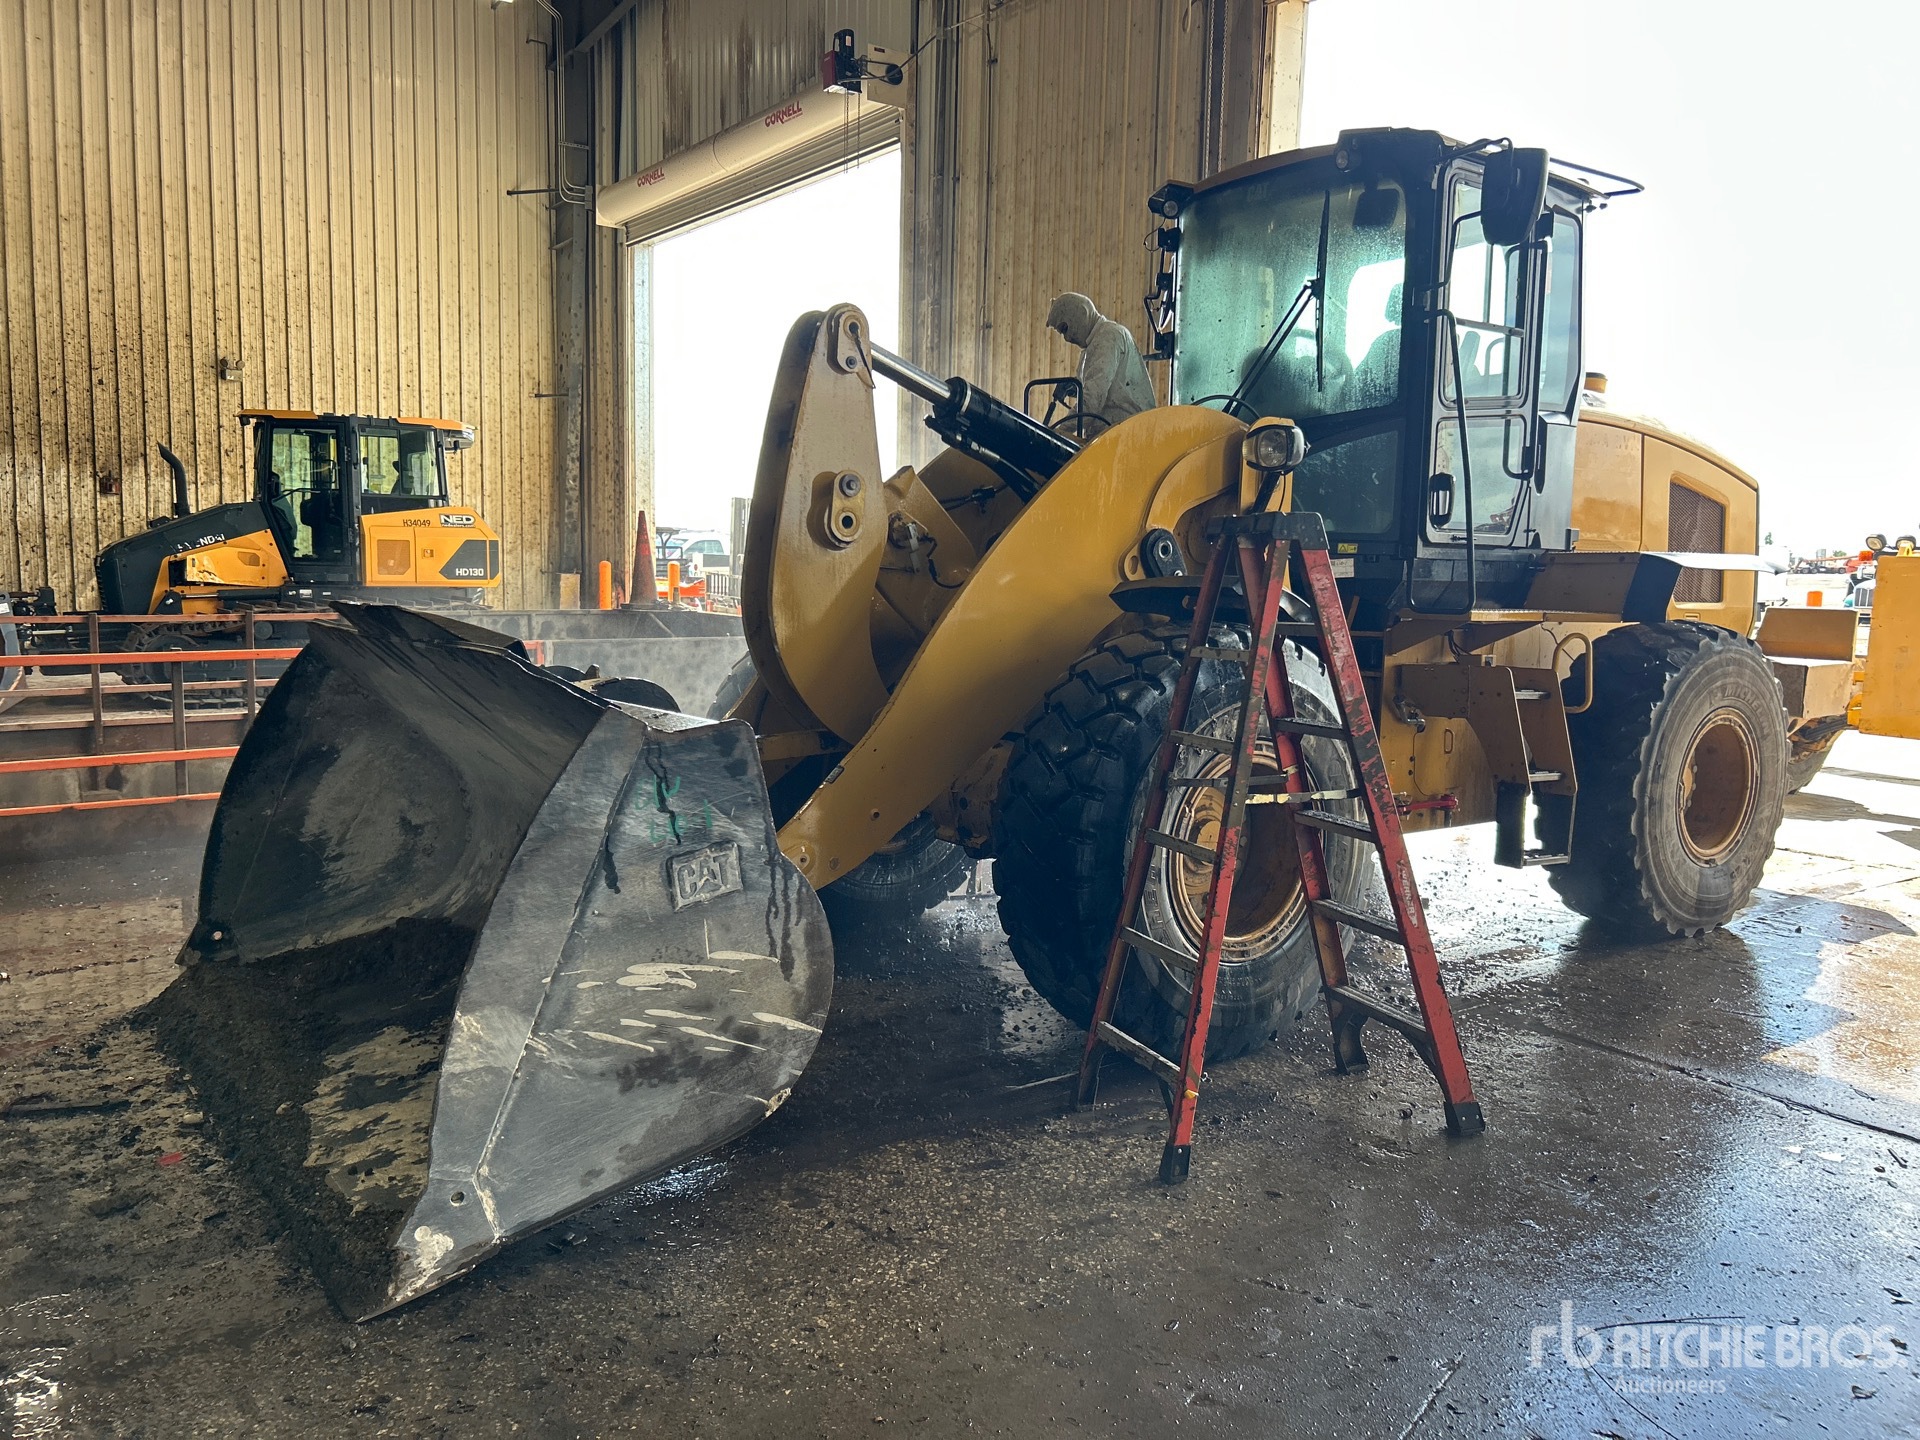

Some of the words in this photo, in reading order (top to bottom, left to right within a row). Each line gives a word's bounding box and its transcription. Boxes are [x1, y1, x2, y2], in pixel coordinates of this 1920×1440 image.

[765, 101, 802, 127] CORNELL
[637, 167, 665, 188] CORNELL
[402, 519, 431, 528] H34049
[440, 514, 475, 524] NED
[455, 567, 484, 577] HD130
[677, 853, 731, 900] CAT
